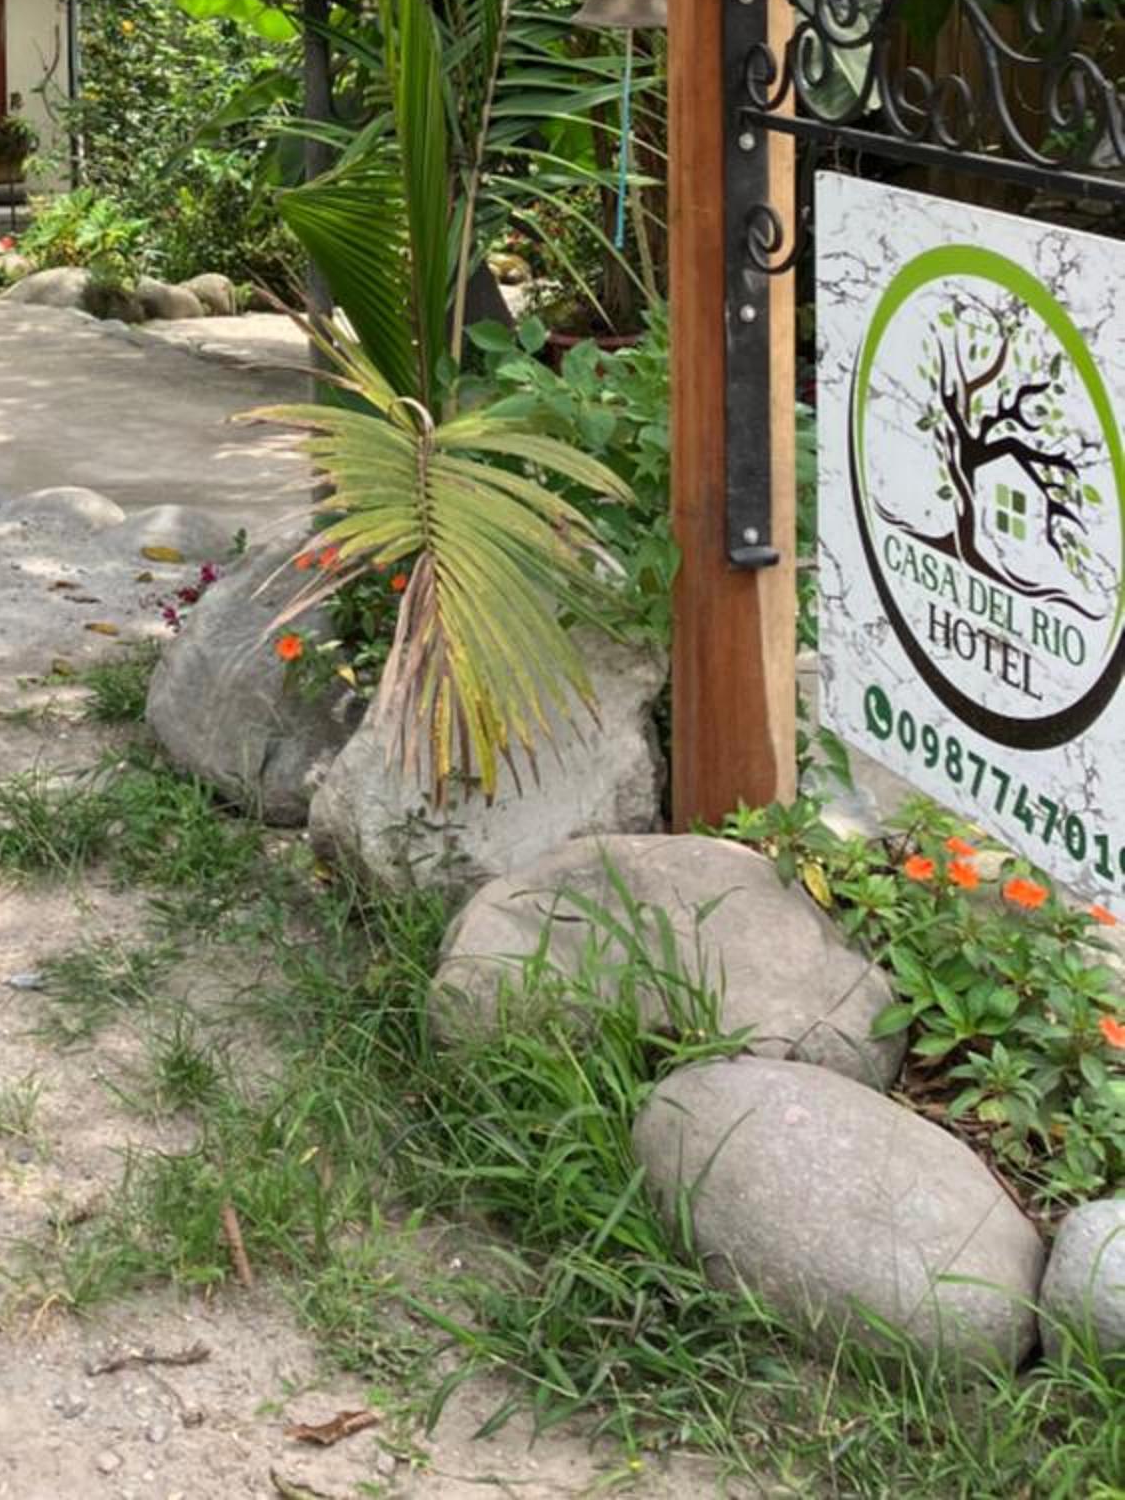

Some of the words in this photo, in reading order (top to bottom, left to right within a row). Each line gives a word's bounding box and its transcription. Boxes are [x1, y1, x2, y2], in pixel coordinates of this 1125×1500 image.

[883, 534, 961, 606] CASA
[968, 575, 1022, 638] DEL
[1030, 606, 1086, 667] RIO
[927, 602, 1043, 701] HOTEL
